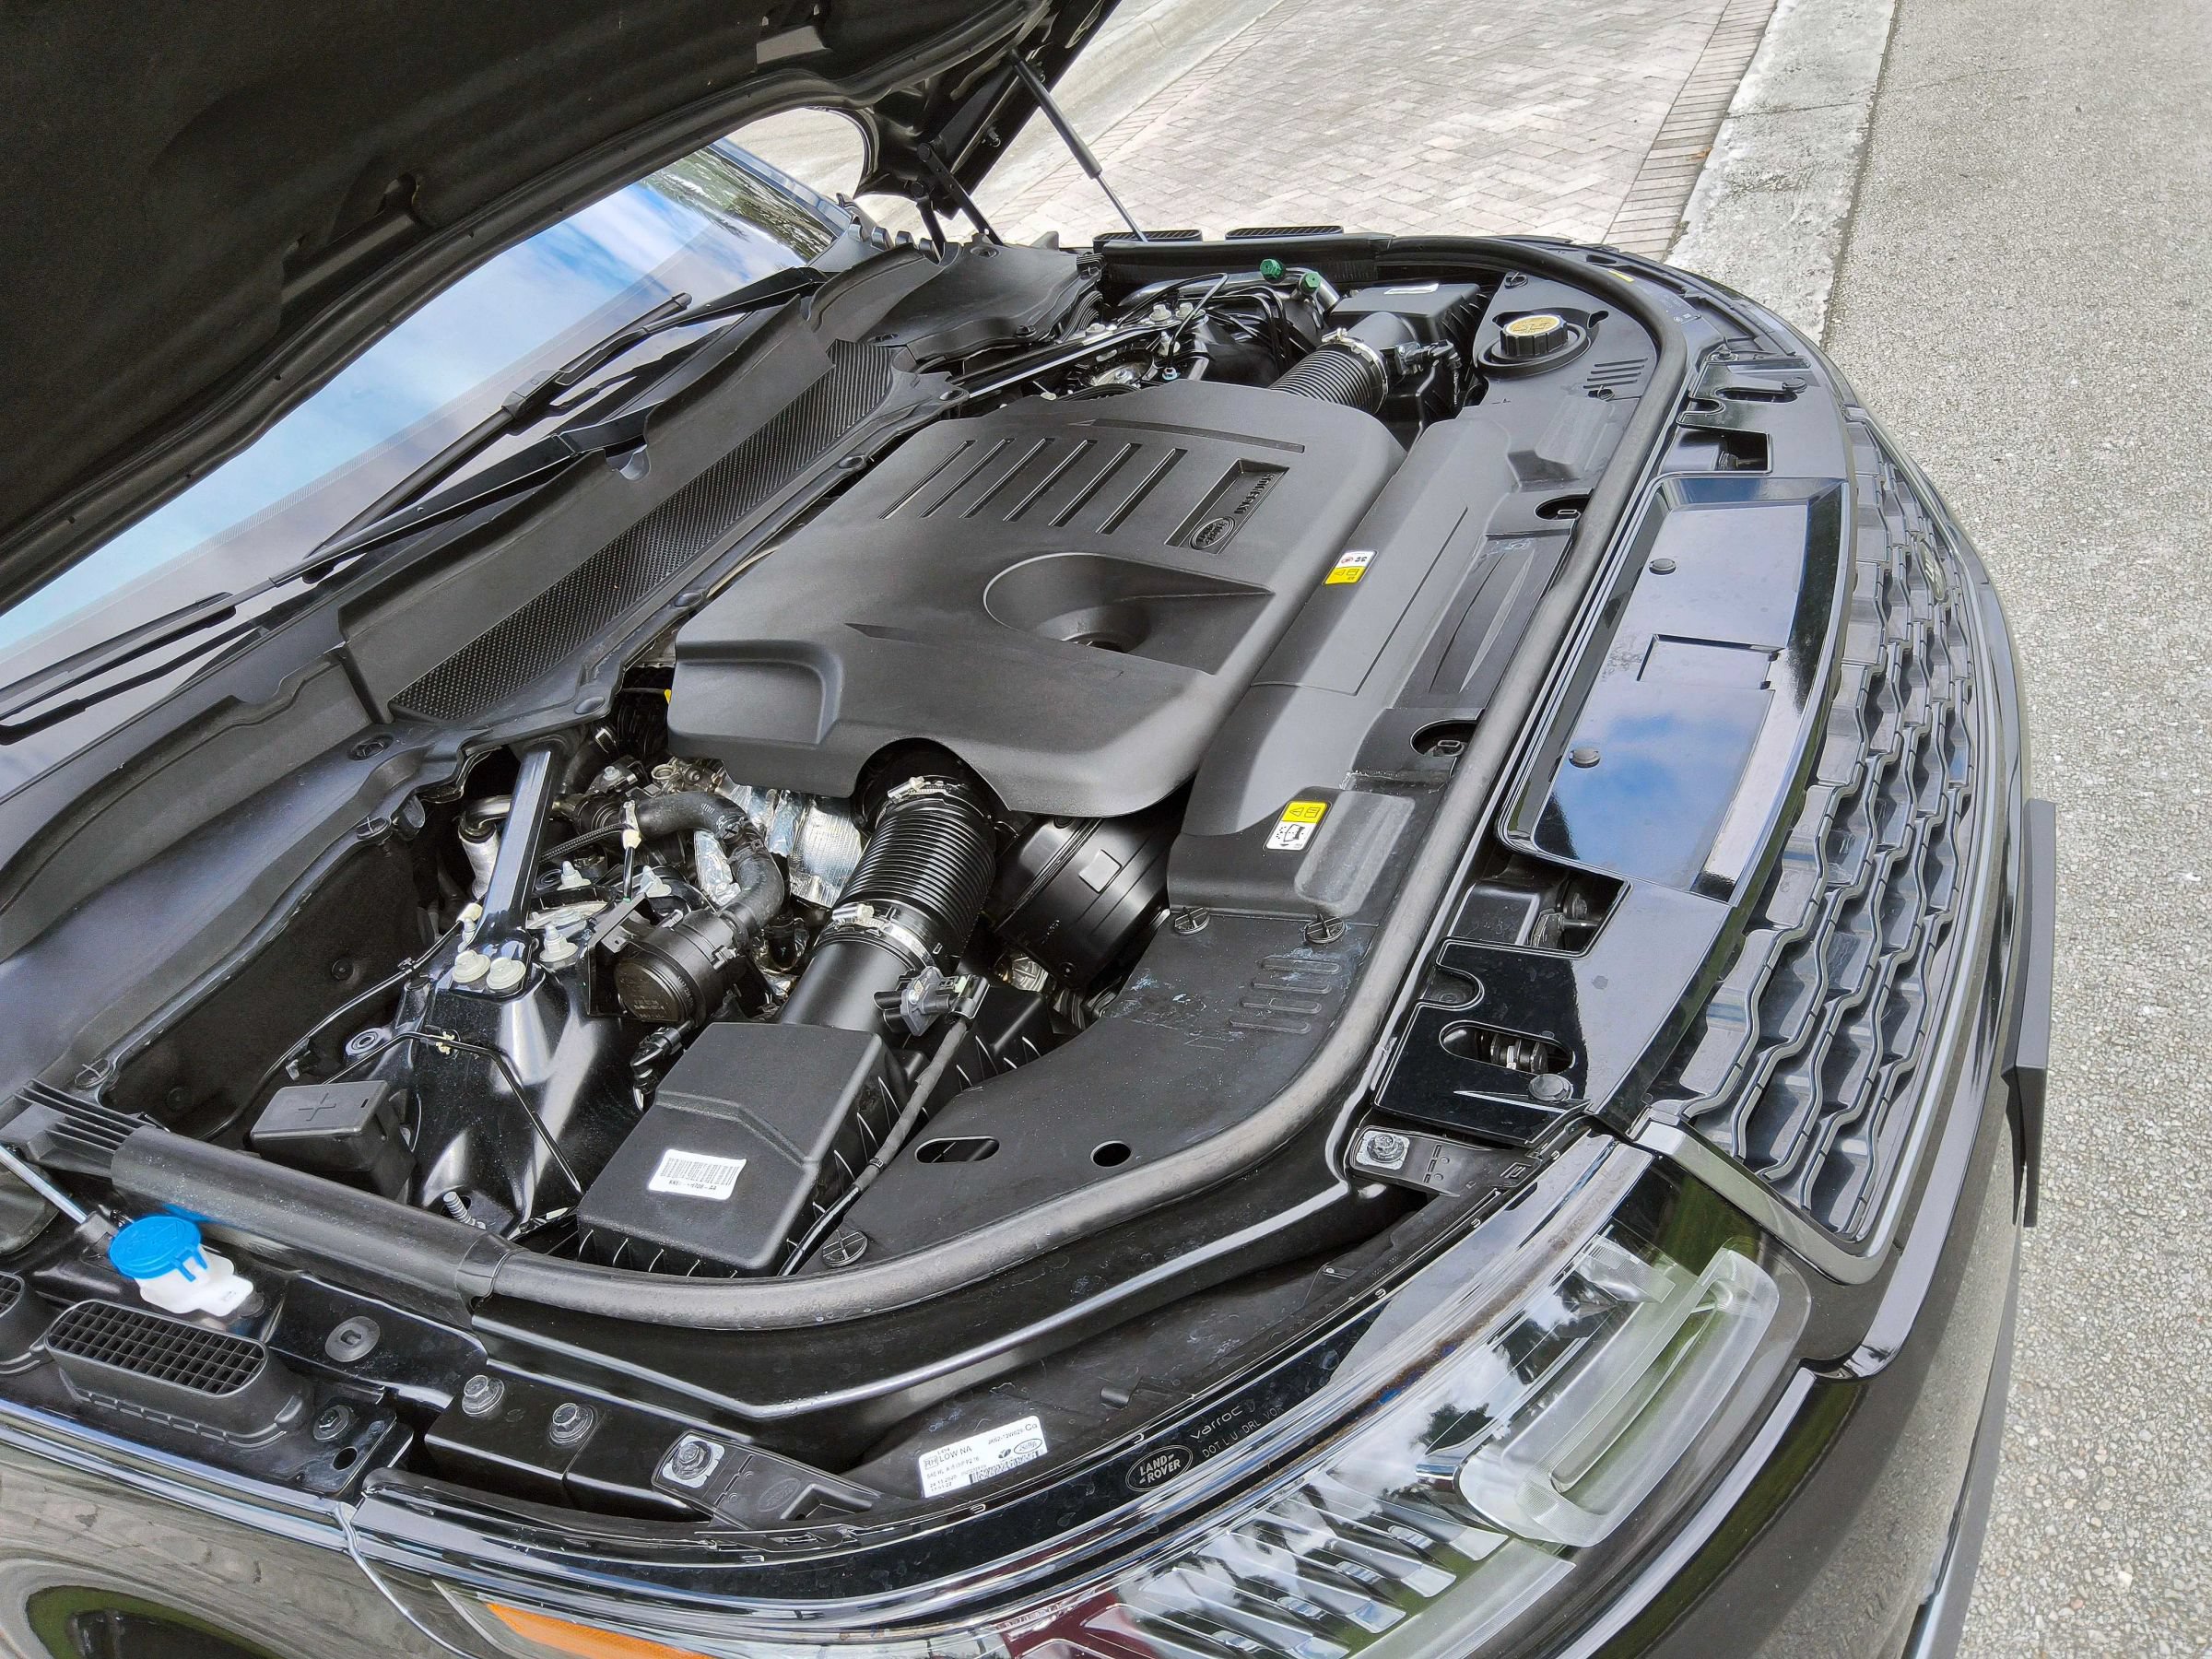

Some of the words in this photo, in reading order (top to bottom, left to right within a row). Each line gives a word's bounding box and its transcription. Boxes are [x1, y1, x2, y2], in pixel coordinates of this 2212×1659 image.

[1190, 1406, 1243, 1440] varroc
[1202, 1441, 1221, 1458] DOT
[1222, 1438, 1230, 1446] L
[1231, 1431, 1239, 1441] U
[1242, 1418, 1262, 1434] DRL
[938, 1449, 959, 1463] LOW
[959, 1444, 972, 1455] NA
[1139, 1454, 1168, 1477] LAND
[1147, 1459, 1181, 1484] ROVER
